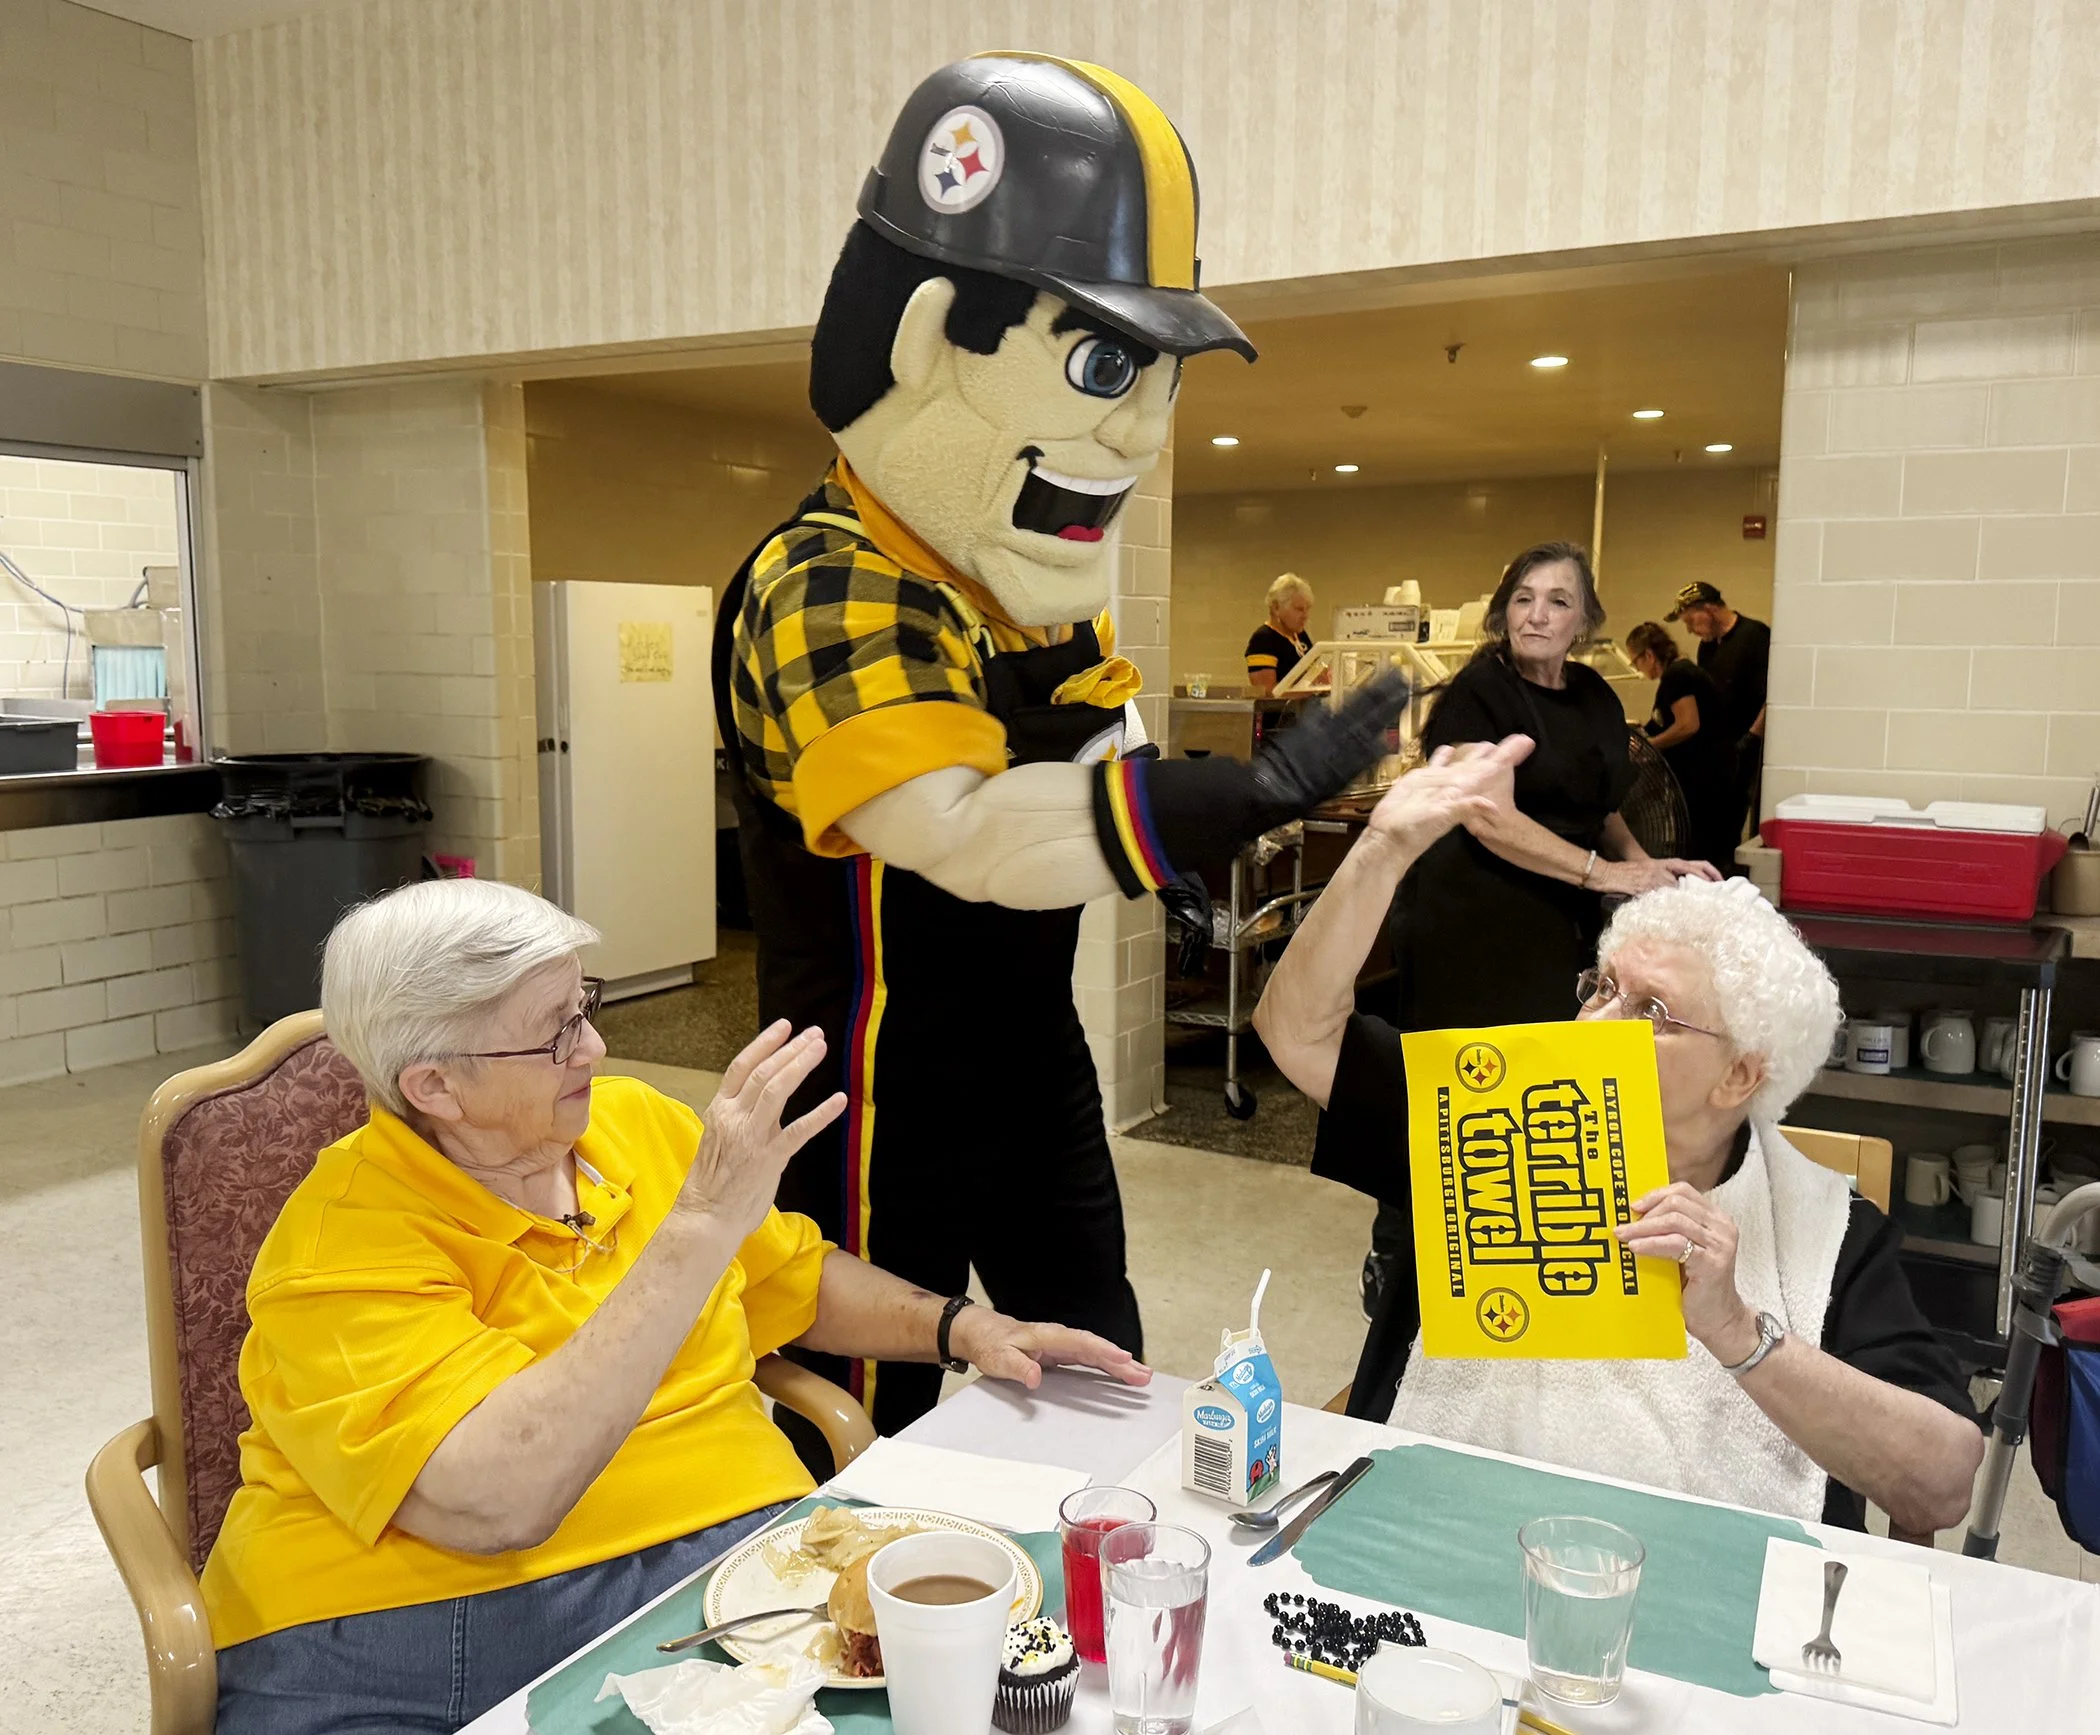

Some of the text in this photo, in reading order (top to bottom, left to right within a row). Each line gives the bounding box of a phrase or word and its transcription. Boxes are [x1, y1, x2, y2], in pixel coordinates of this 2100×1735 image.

[1438, 1094, 1464, 1293] A PITTSBURGH ORIGINAL
[1457, 1108, 1538, 1265] towel
[1522, 1079, 1610, 1296] terrible
[1584, 1110, 1599, 1161] The
[1605, 1085, 1636, 1290] MYRON COPE'S OICIAL
